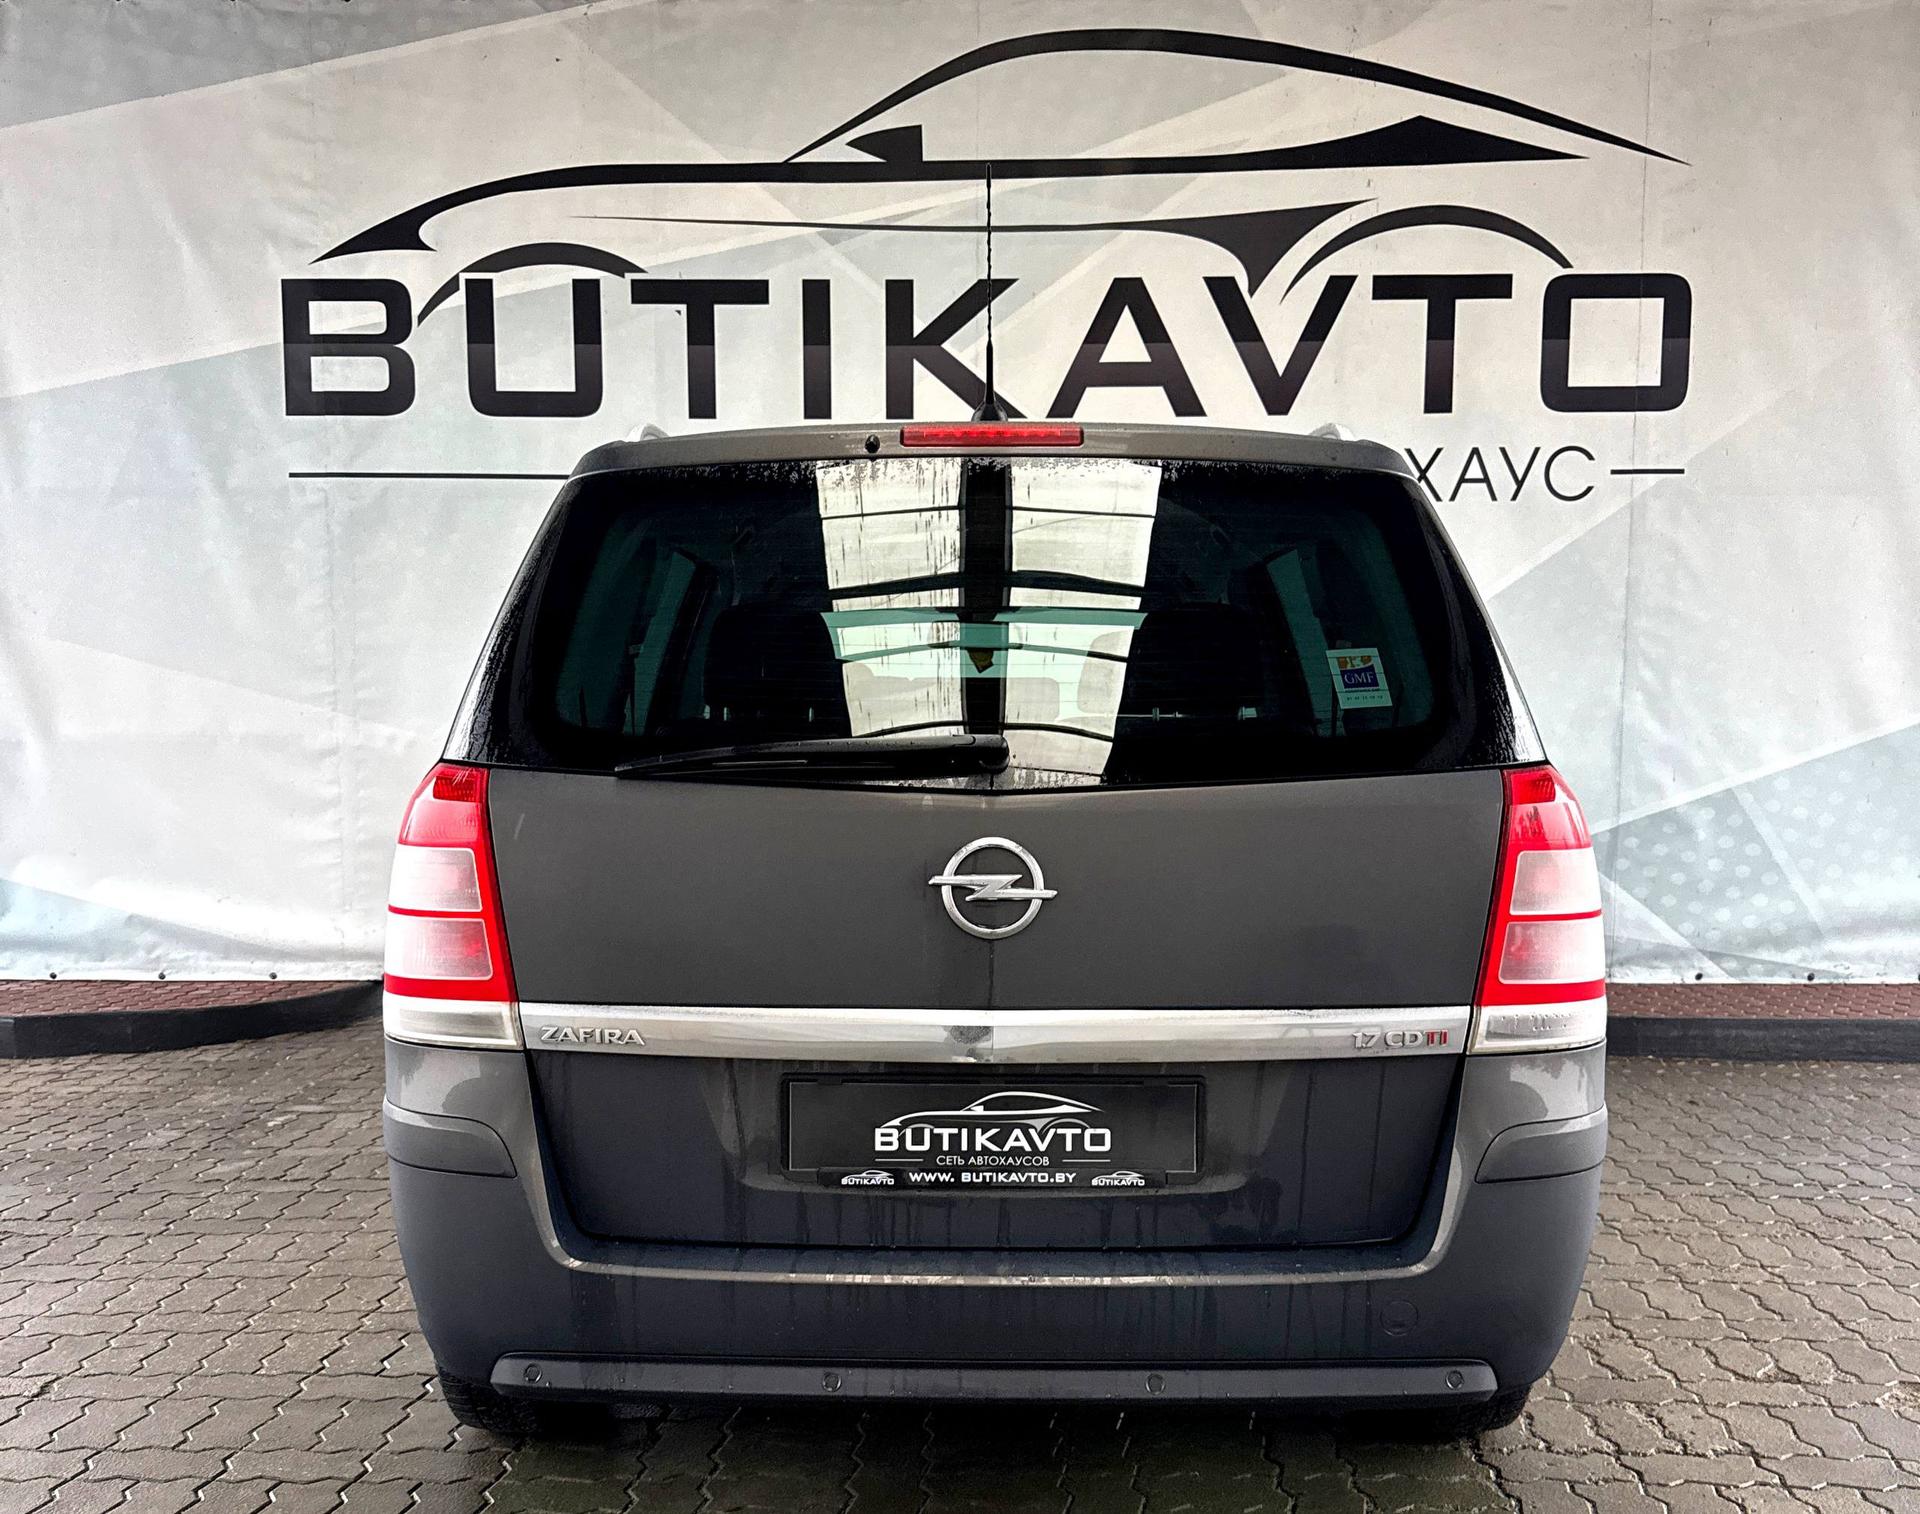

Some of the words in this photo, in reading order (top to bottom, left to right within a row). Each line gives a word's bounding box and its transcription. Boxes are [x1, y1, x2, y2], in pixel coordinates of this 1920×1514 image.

[281, 273, 1692, 420] BUTIKAVTO
[1344, 671, 1375, 685] GMF
[540, 1025, 646, 1046] ZAFIRA
[1384, 1029, 1449, 1048] CDTI
[874, 1127, 1112, 1152] BUTIKAVTO
[936, 1155, 965, 1167] СЕТЬ
[968, 1155, 1050, 1167] АВТОХАУСОВ
[841, 1177, 895, 1186] BUTIKAVTO
[1091, 1178, 1146, 1187] BUTIKAVTO
